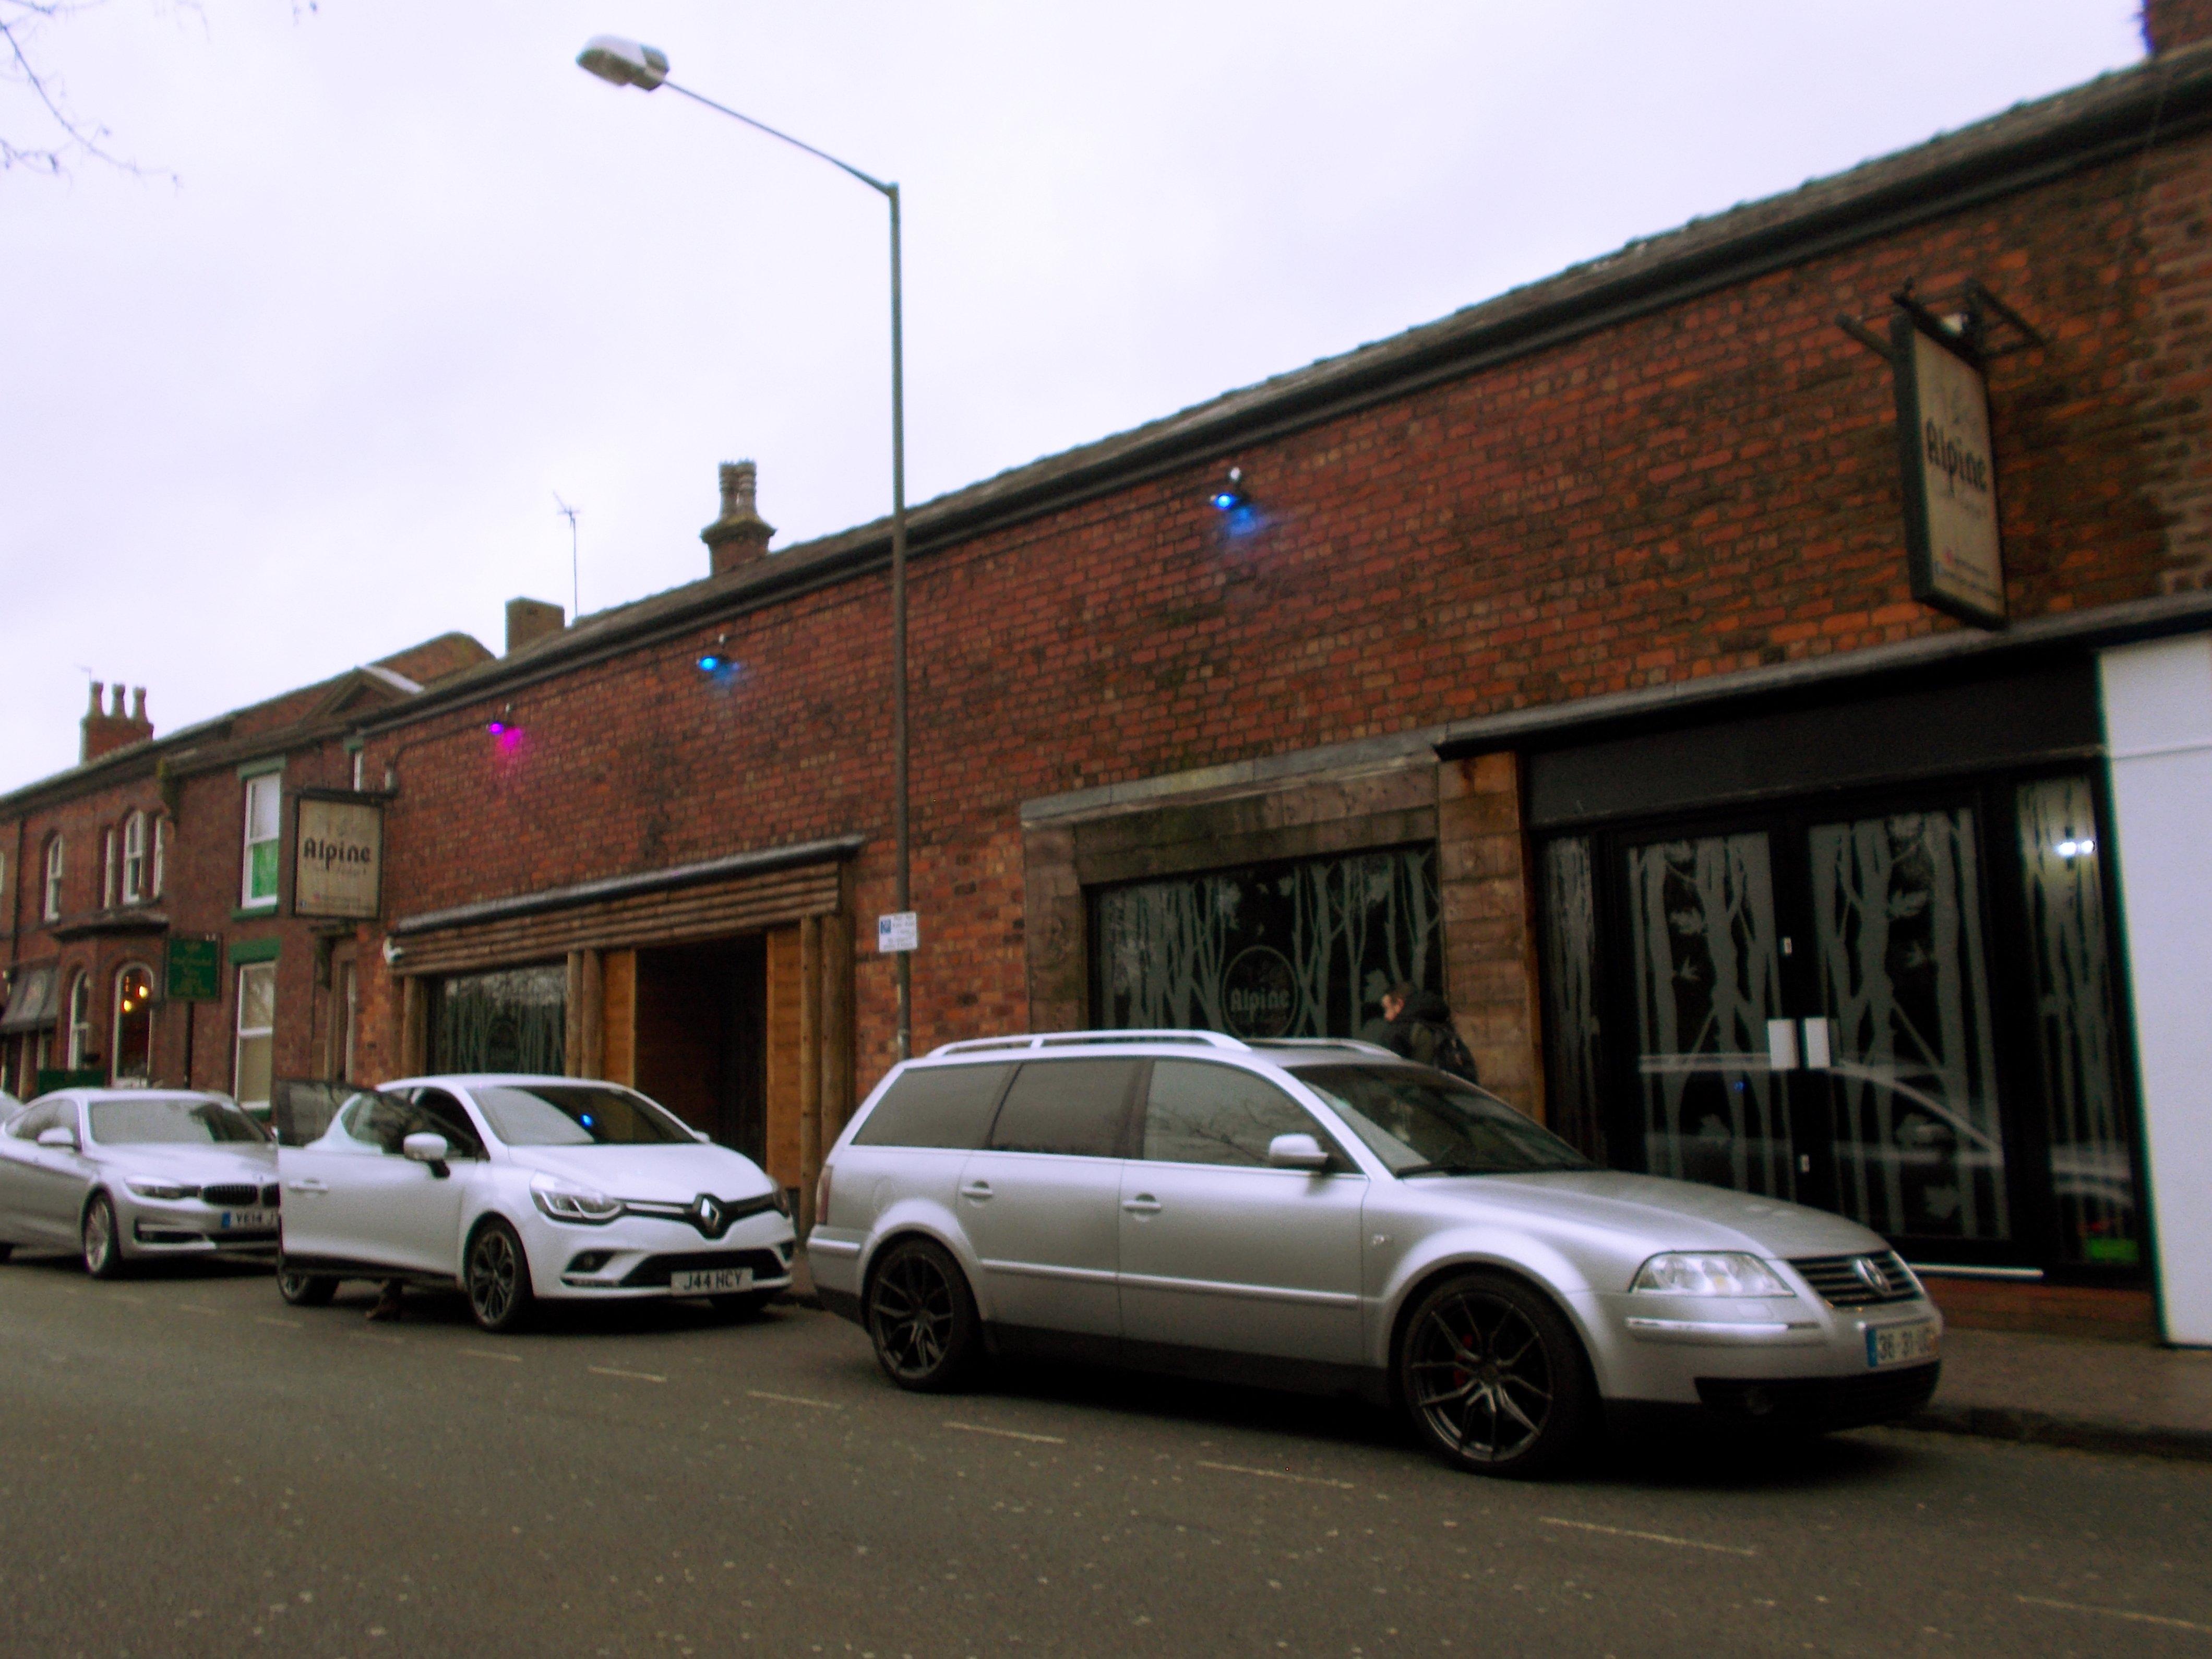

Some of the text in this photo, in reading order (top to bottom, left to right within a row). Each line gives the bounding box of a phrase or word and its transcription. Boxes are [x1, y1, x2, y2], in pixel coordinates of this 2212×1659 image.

[1927, 417, 1987, 498] Alpine
[303, 837, 371, 871] Alpine
[1230, 987, 1290, 1023] Alpine
[683, 1272, 711, 1291] J44
